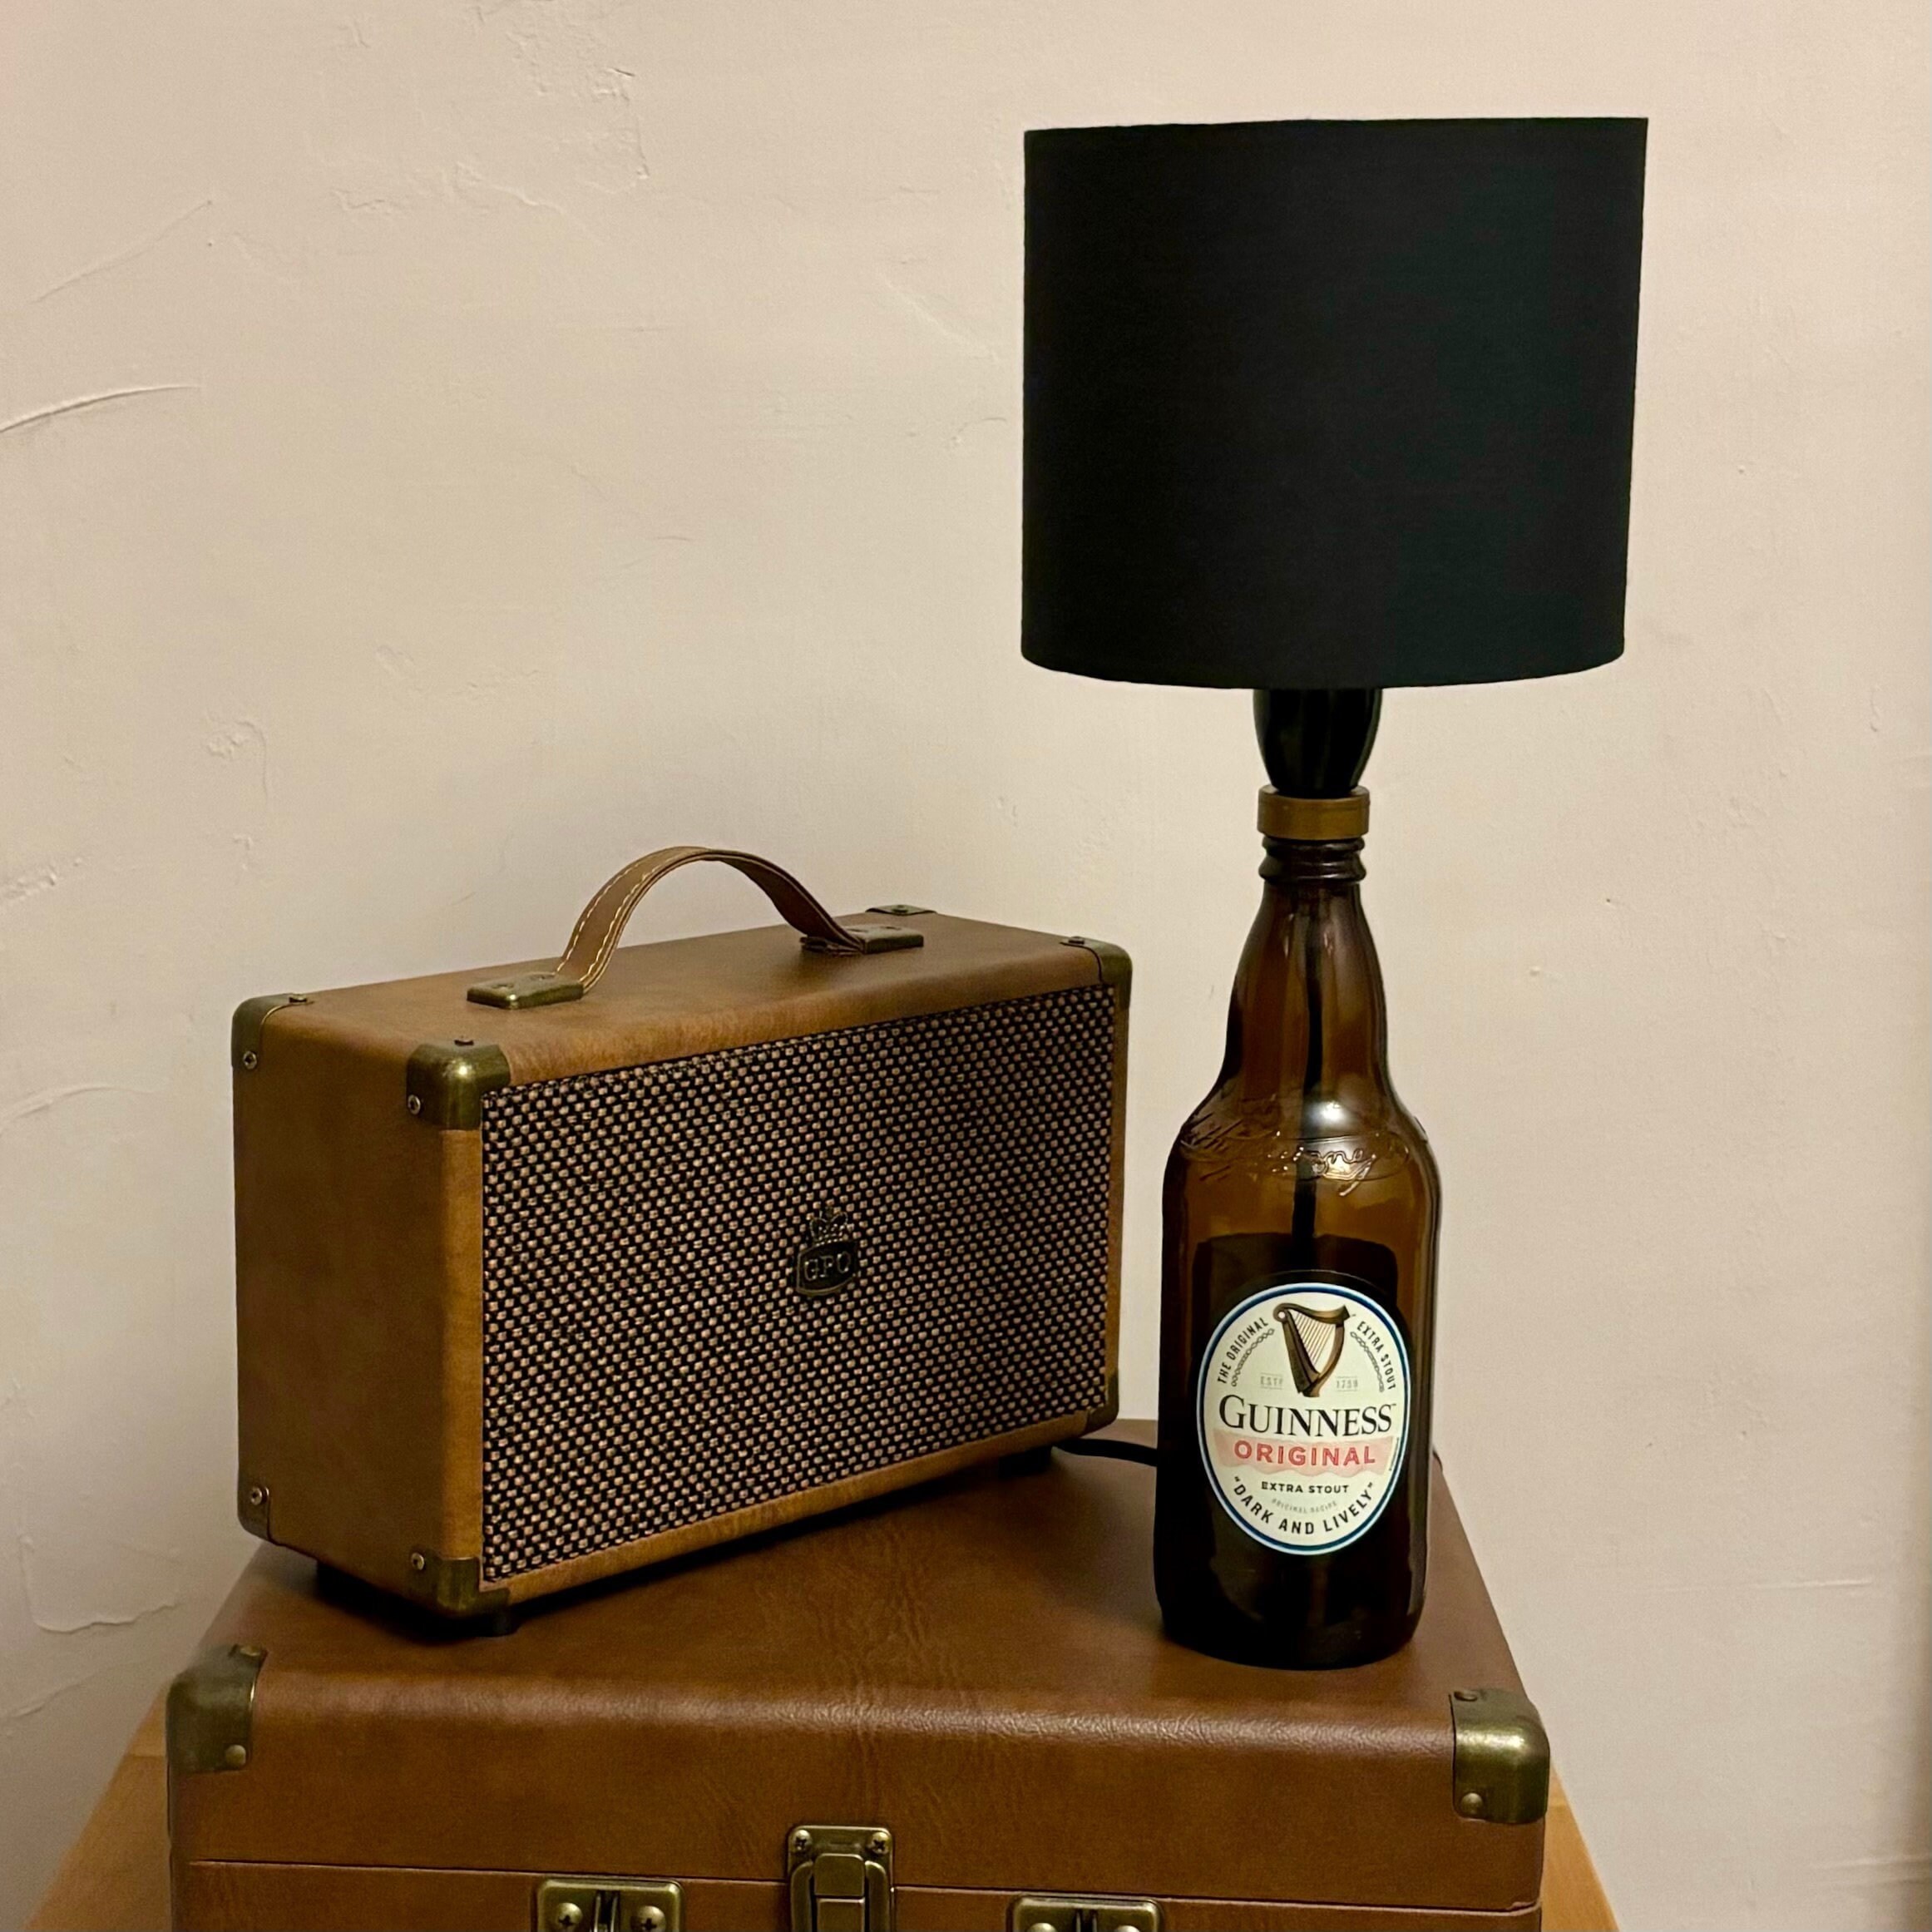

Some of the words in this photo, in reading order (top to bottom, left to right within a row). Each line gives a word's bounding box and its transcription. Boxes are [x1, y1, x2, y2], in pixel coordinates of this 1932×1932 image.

[803, 1251, 852, 1281] GPO
[1217, 1361, 1232, 1384] THE
[1226, 1317, 1269, 1361] ORIGINAL
[1356, 1321, 1384, 1354] EXTRA
[1381, 1353, 1396, 1390] STOUT
[1218, 1394, 1393, 1437] GUINNESS
[1233, 1440, 1376, 1466] ORIGINAL
[1261, 1480, 1304, 1494] EXTRA
[1308, 1485, 1350, 1495] STOUT
[1277, 1518, 1315, 1535] AND
